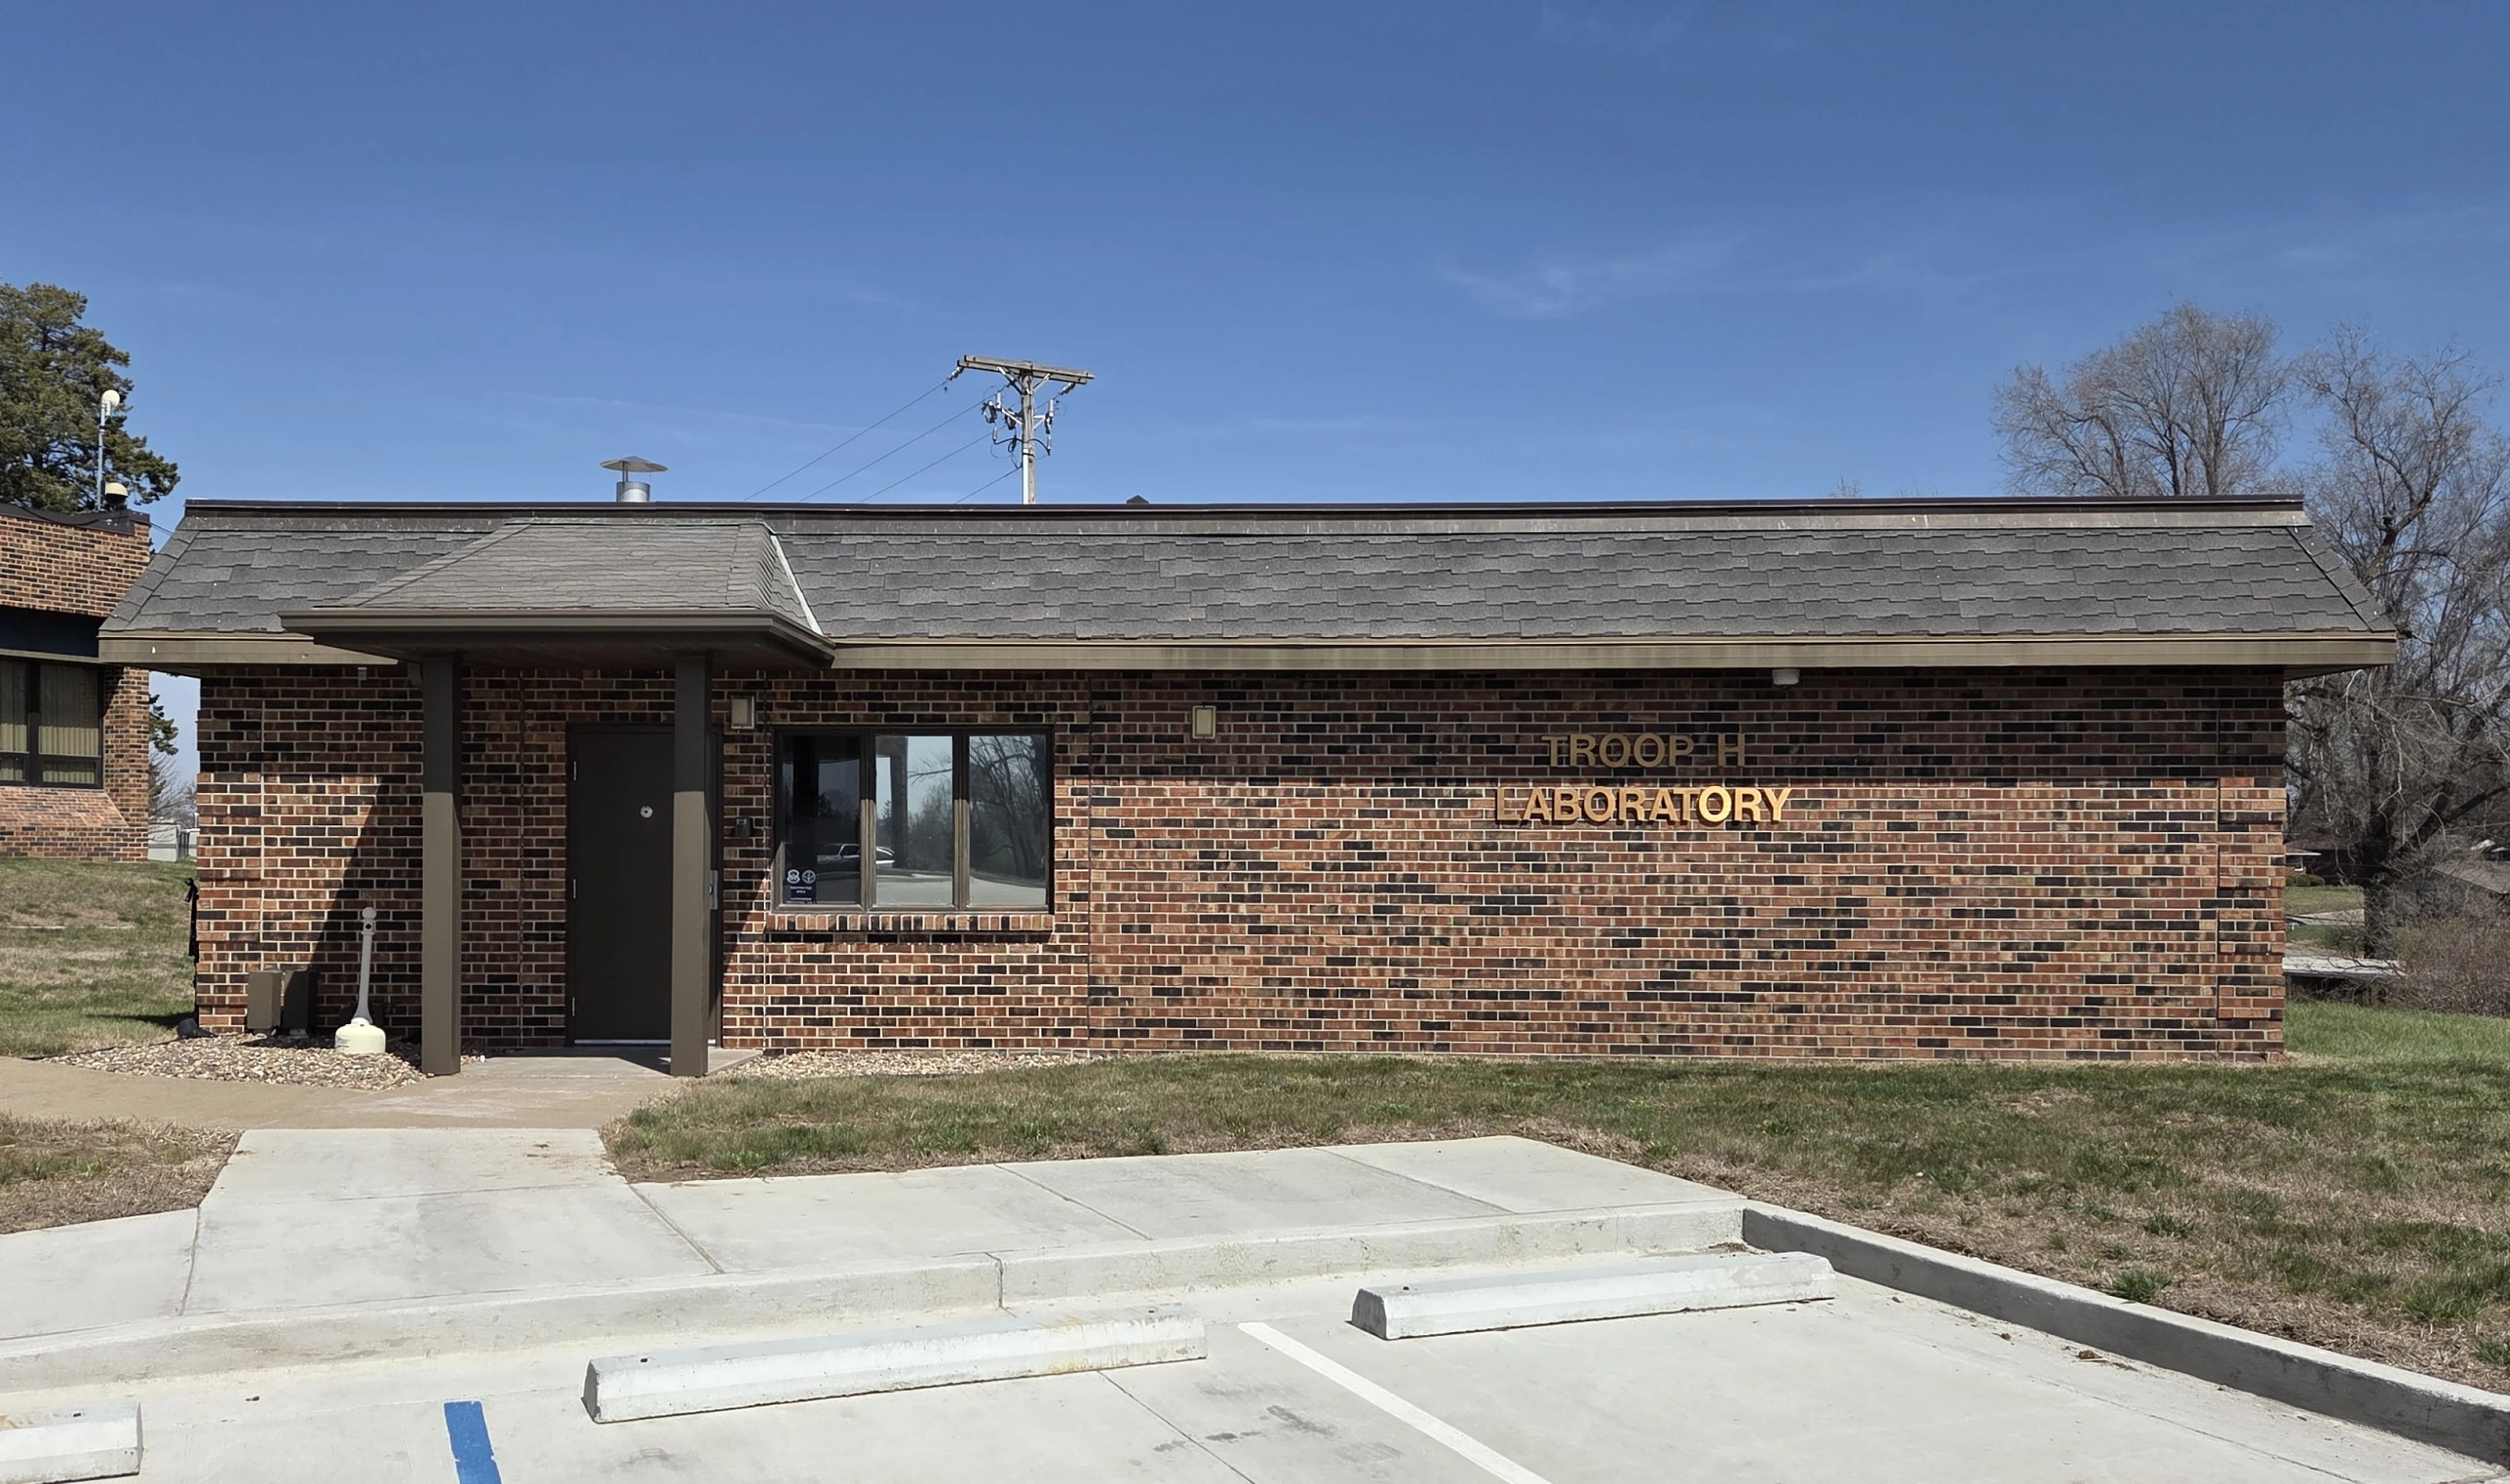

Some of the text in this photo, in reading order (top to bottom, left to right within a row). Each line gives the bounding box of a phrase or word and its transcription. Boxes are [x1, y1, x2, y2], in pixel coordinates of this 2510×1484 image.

[1541, 733, 1746, 767] TROOP H
[1496, 785, 1791, 822] LABORATORY
